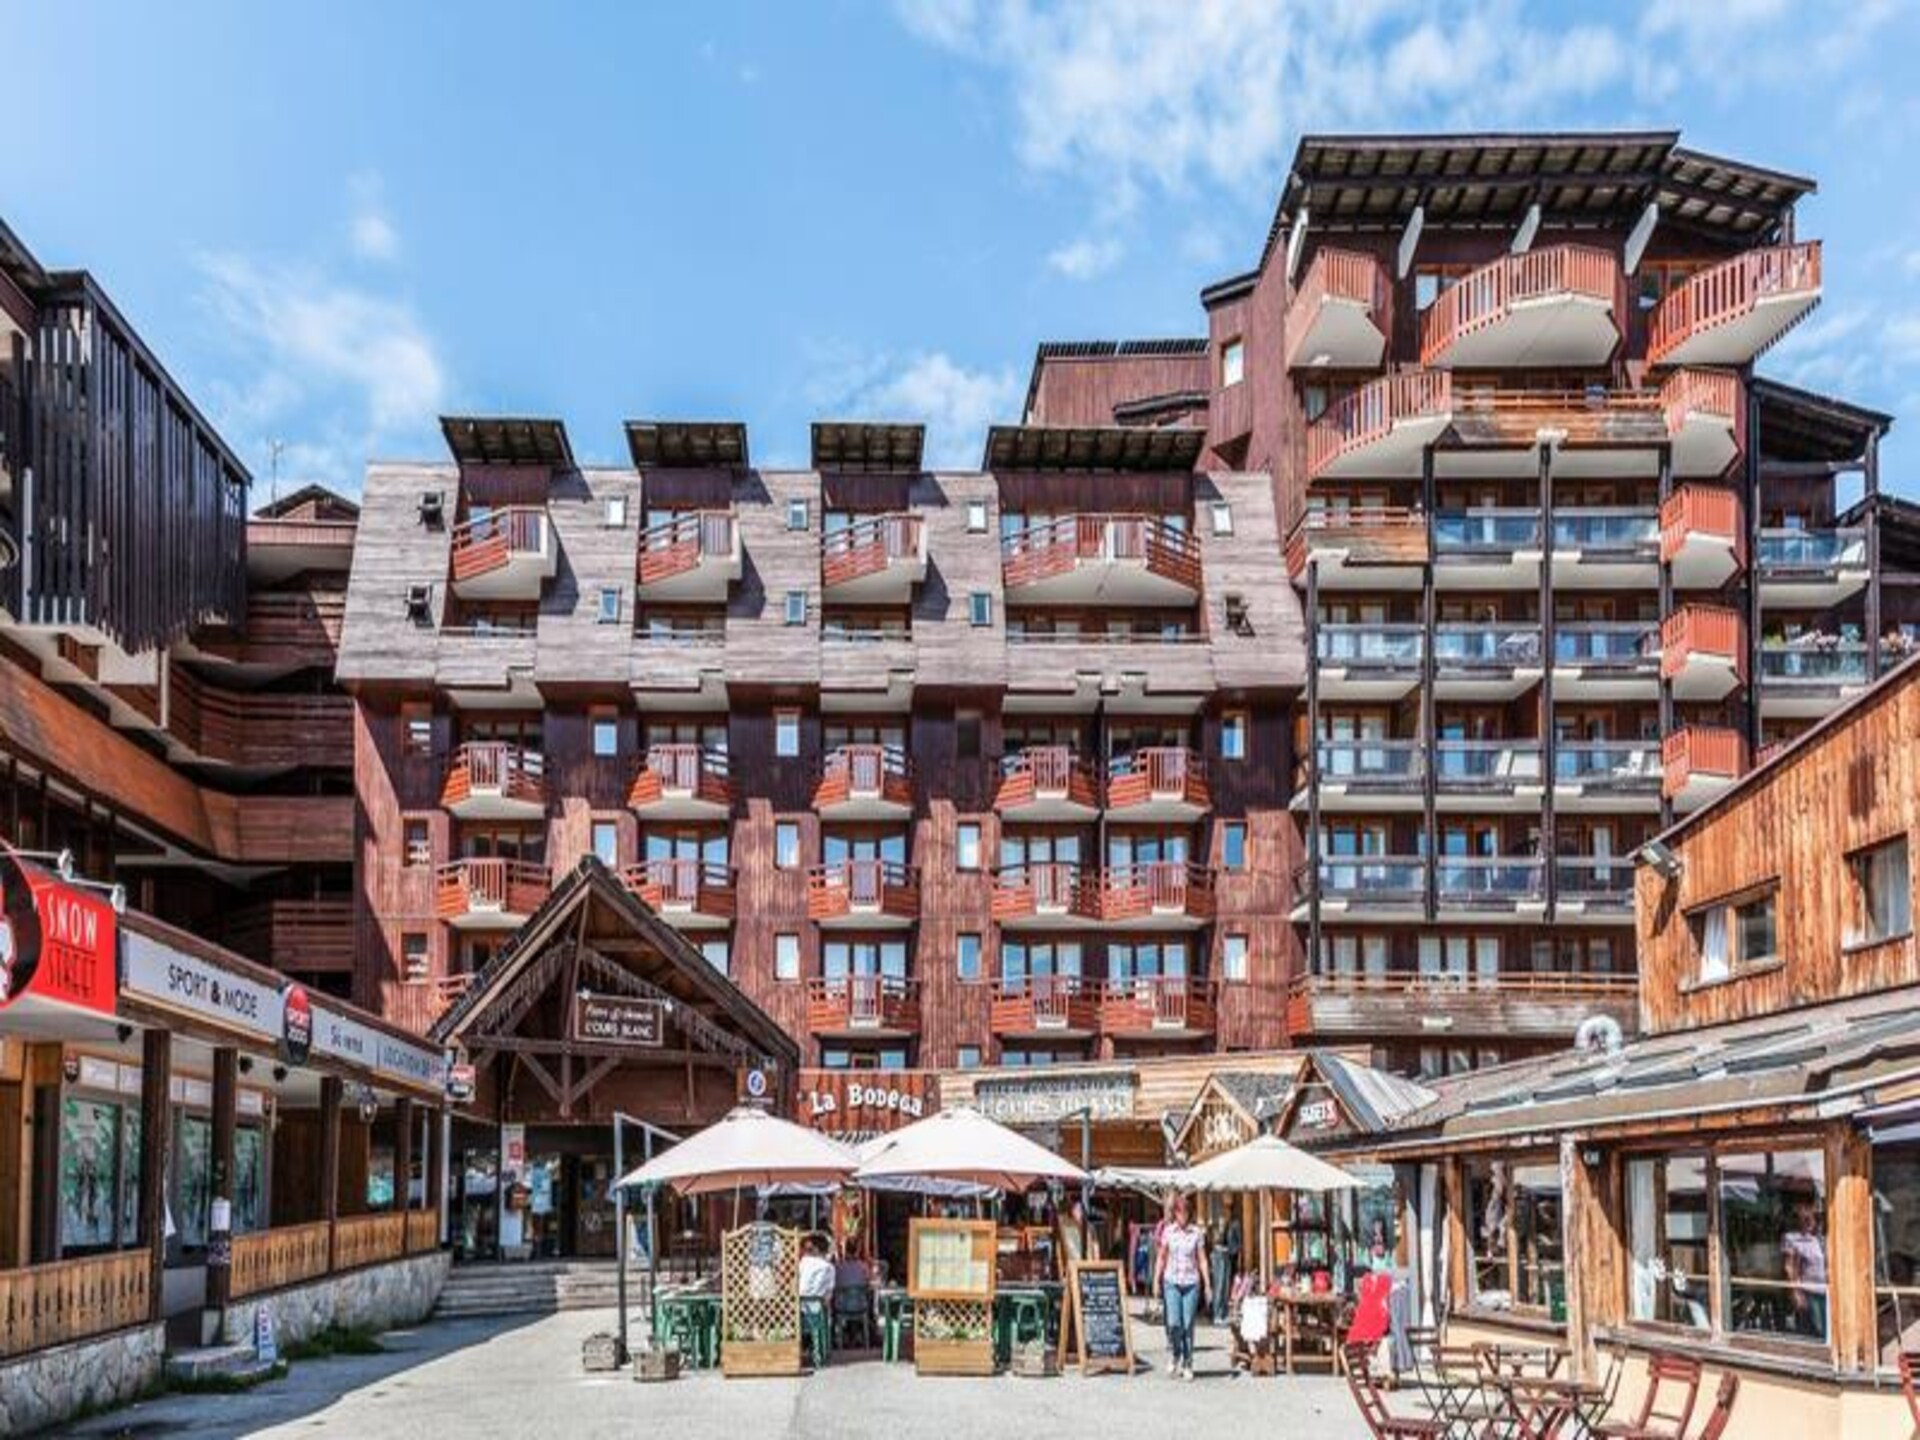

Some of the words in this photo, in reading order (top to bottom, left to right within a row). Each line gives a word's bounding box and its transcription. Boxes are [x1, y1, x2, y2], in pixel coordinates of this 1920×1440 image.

[47, 892, 97, 951] SNOW
[168, 964, 207, 998] SPORT
[211, 980, 221, 1006] &
[224, 988, 258, 1018] MODE
[621, 1023, 654, 1038] BLANC
[809, 1091, 836, 1114] La
